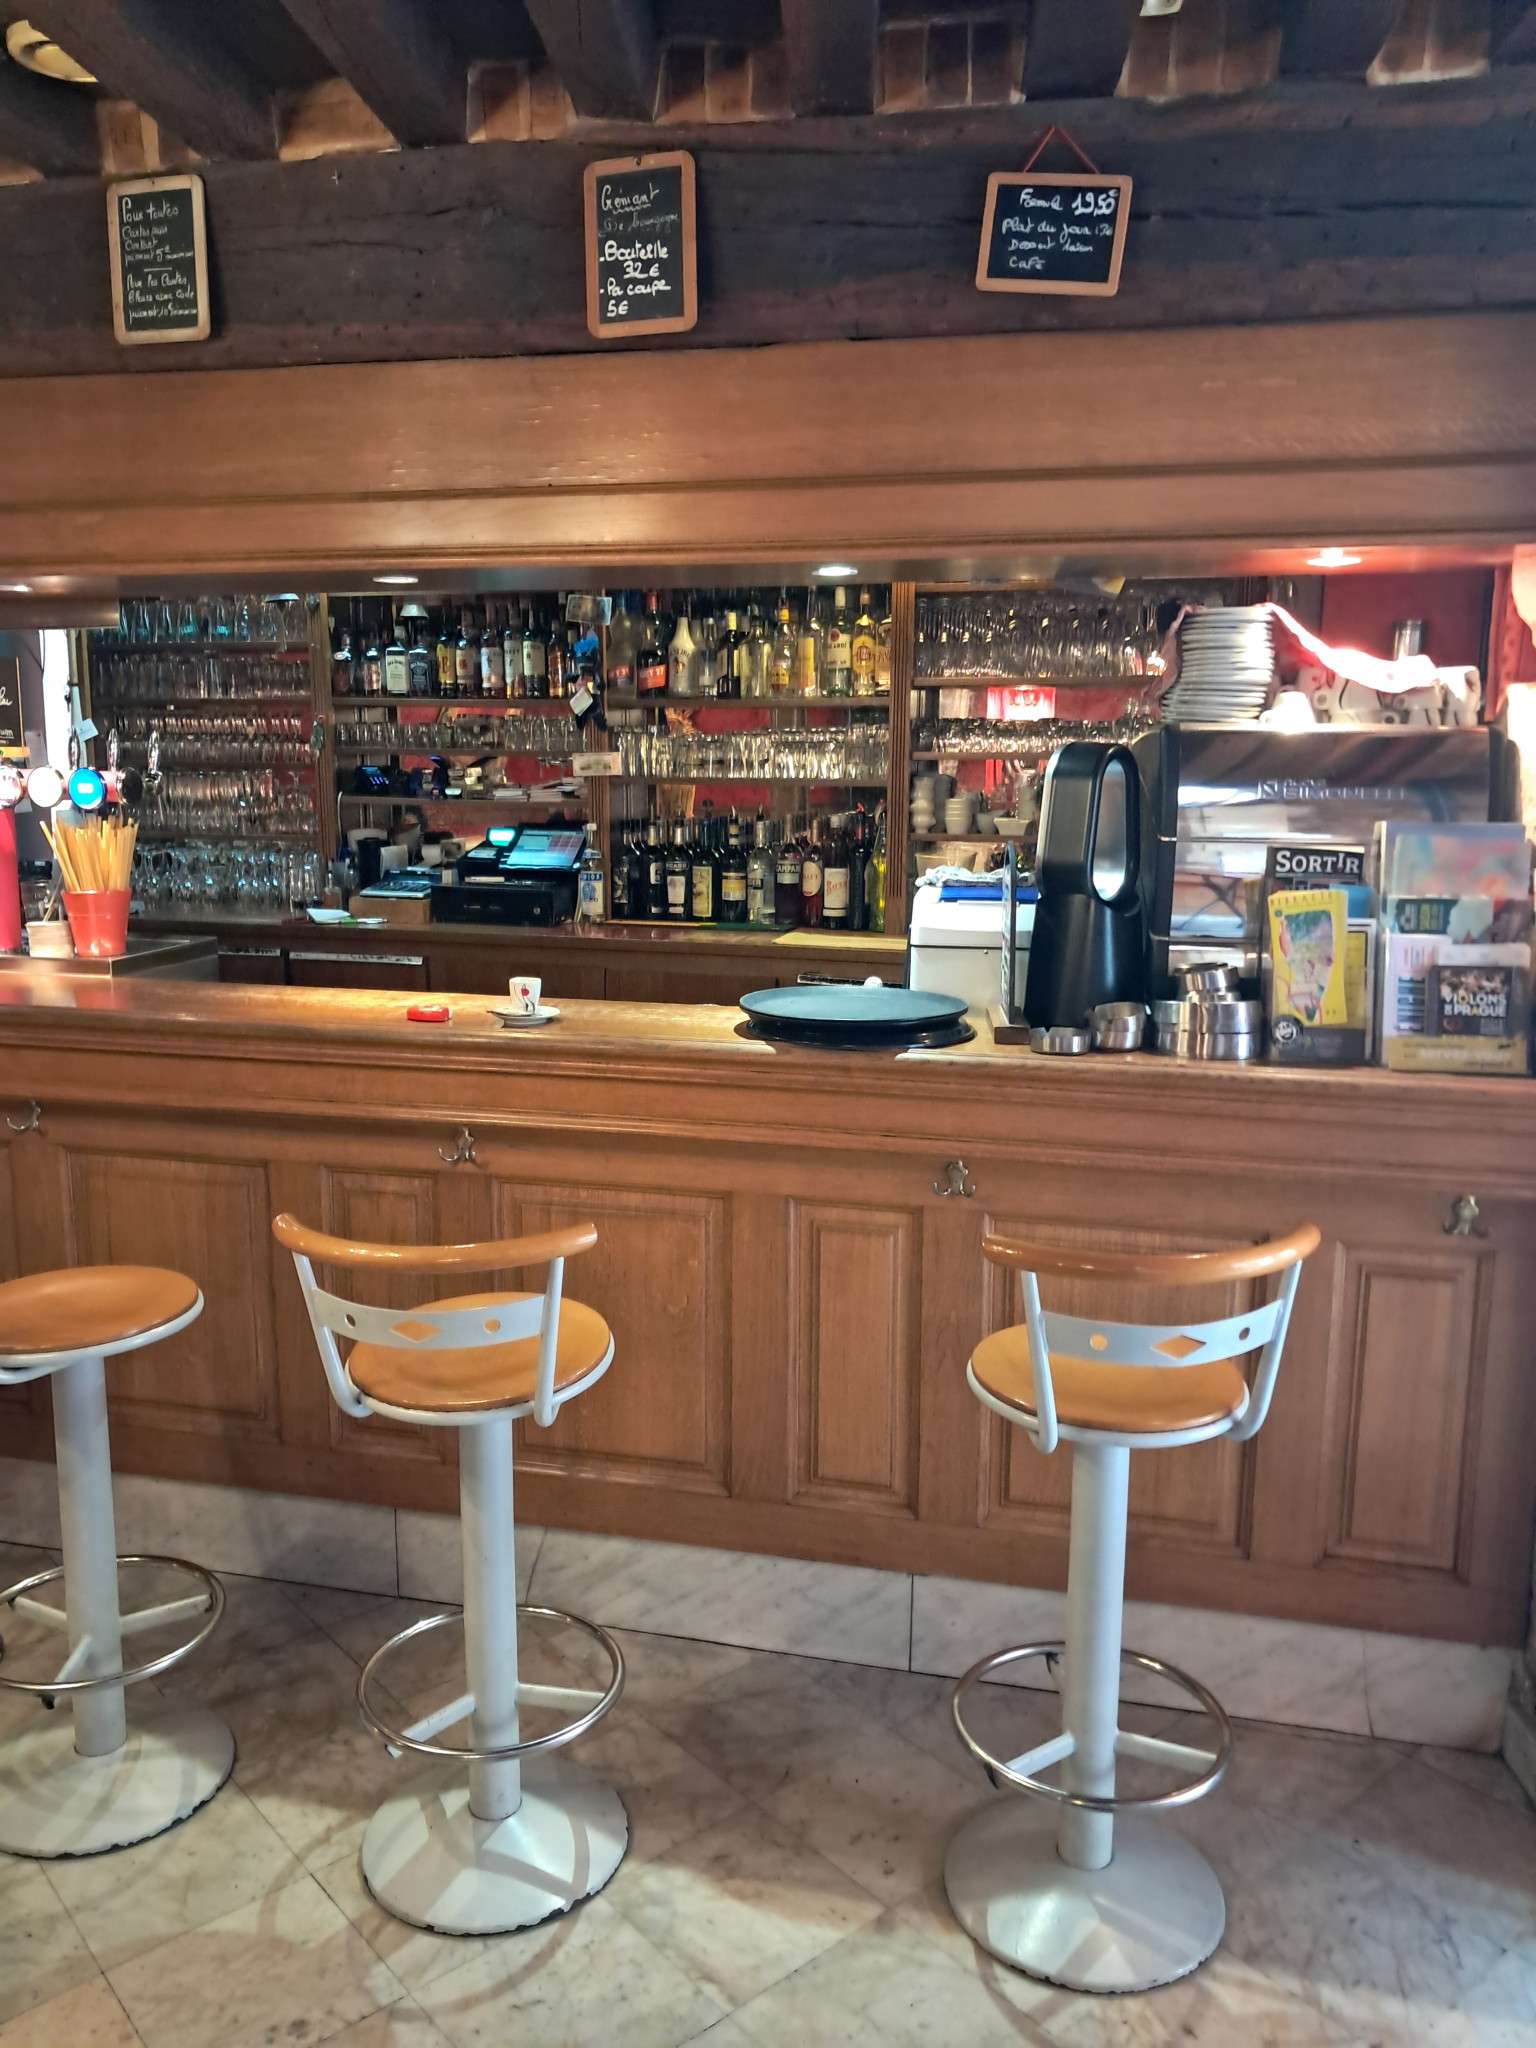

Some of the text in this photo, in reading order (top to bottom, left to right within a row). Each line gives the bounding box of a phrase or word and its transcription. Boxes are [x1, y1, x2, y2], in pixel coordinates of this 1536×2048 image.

[121, 197, 144, 224] Pour
[1001, 216, 1035, 235] Plat
[1037, 220, 1057, 233] du
[1441, 991, 1508, 1006] VIOLONS
[1453, 1004, 1508, 1017] PRAGUE
